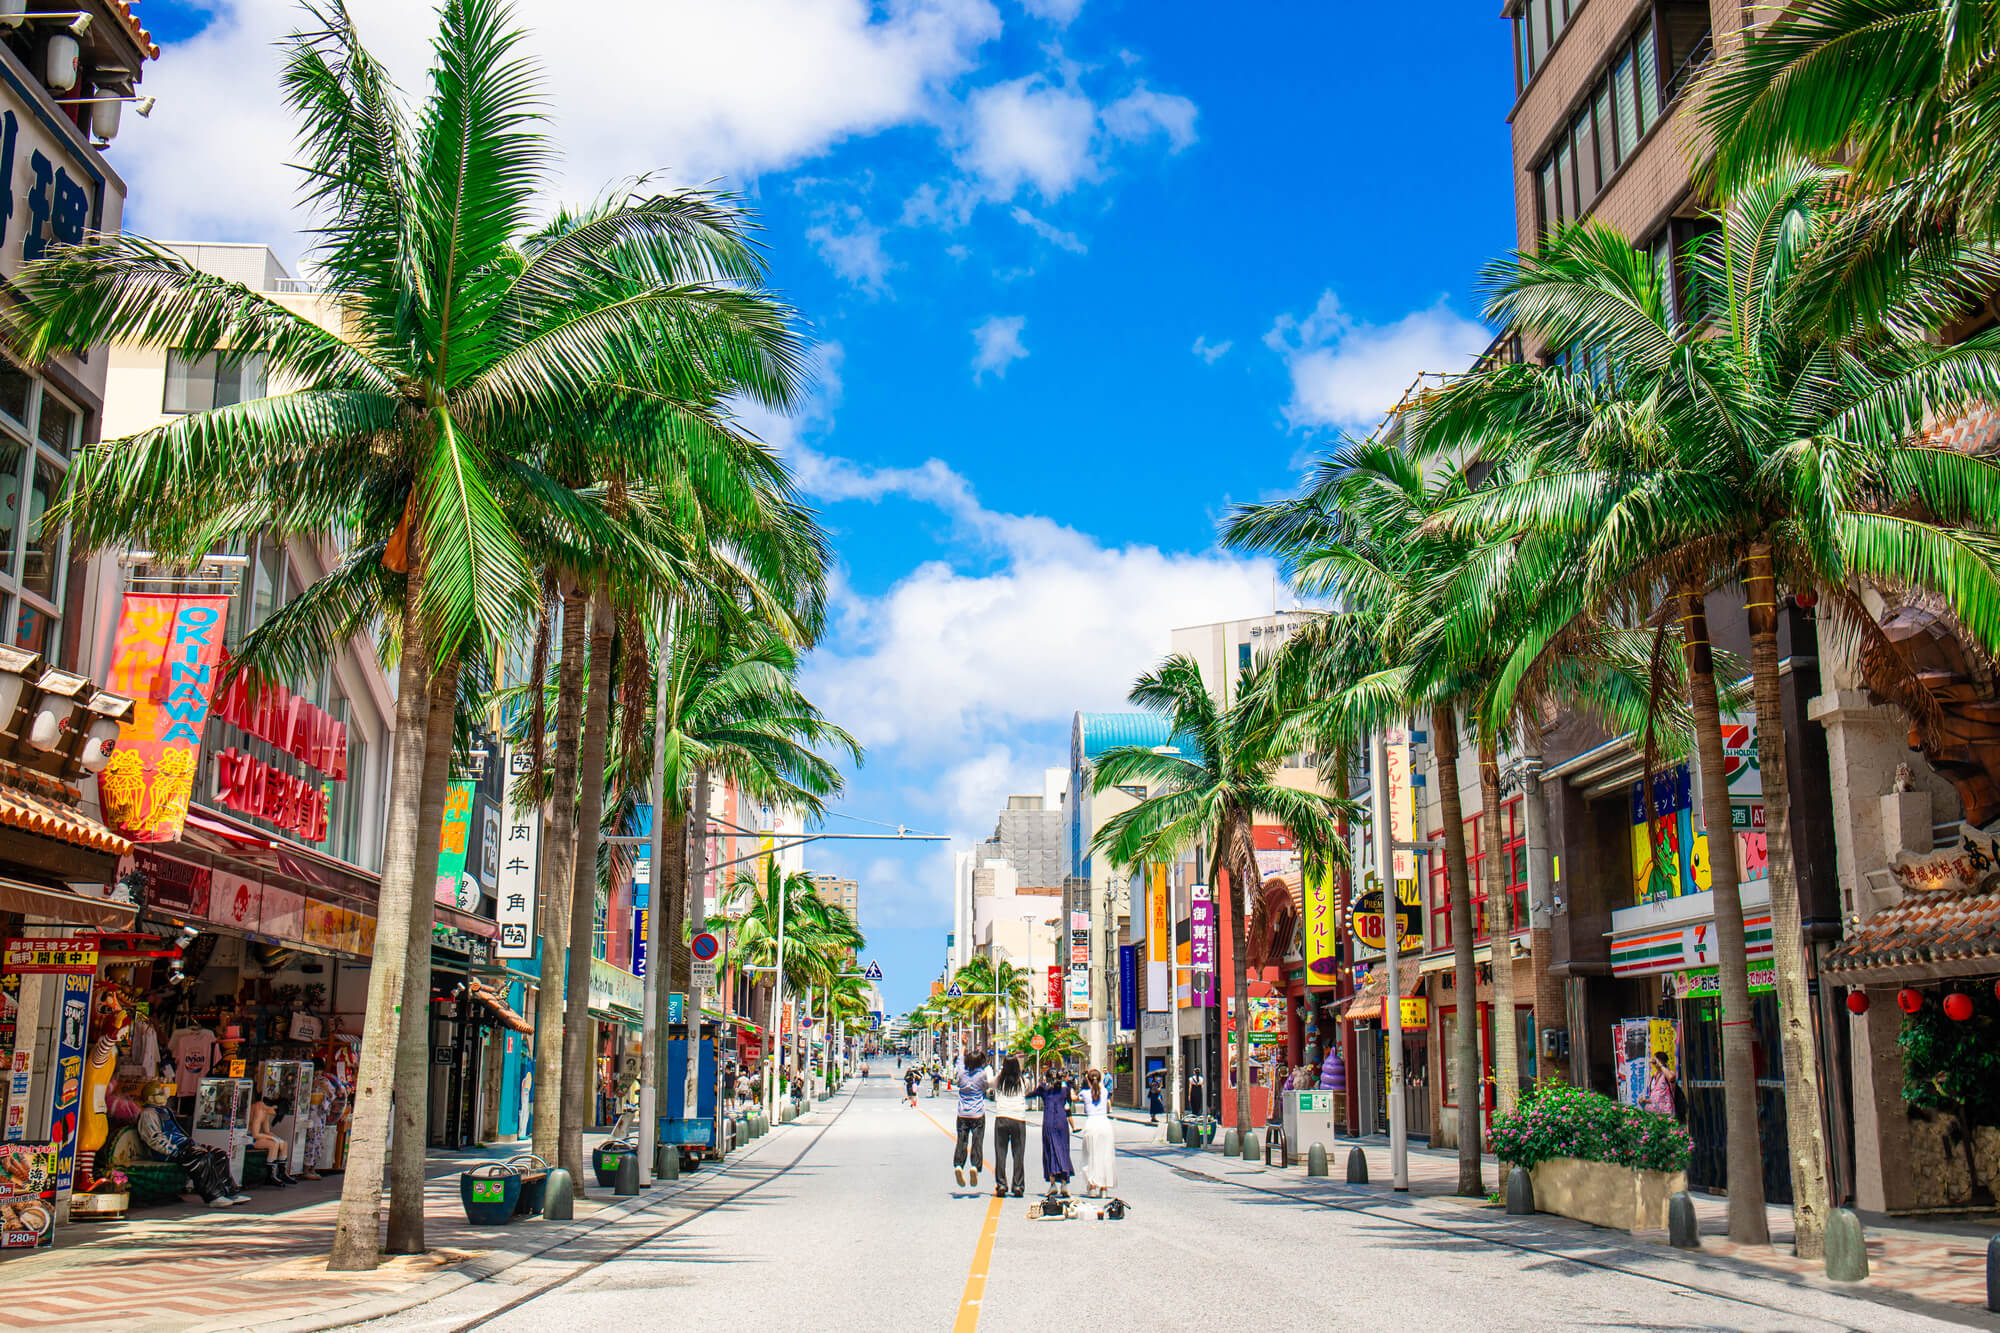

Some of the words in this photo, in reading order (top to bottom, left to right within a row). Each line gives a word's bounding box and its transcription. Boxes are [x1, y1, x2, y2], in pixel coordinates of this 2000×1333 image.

[161, 606, 219, 745] OKINAWA
[1731, 809, 1746, 824] 酒
[66, 975, 90, 993] SPAM
